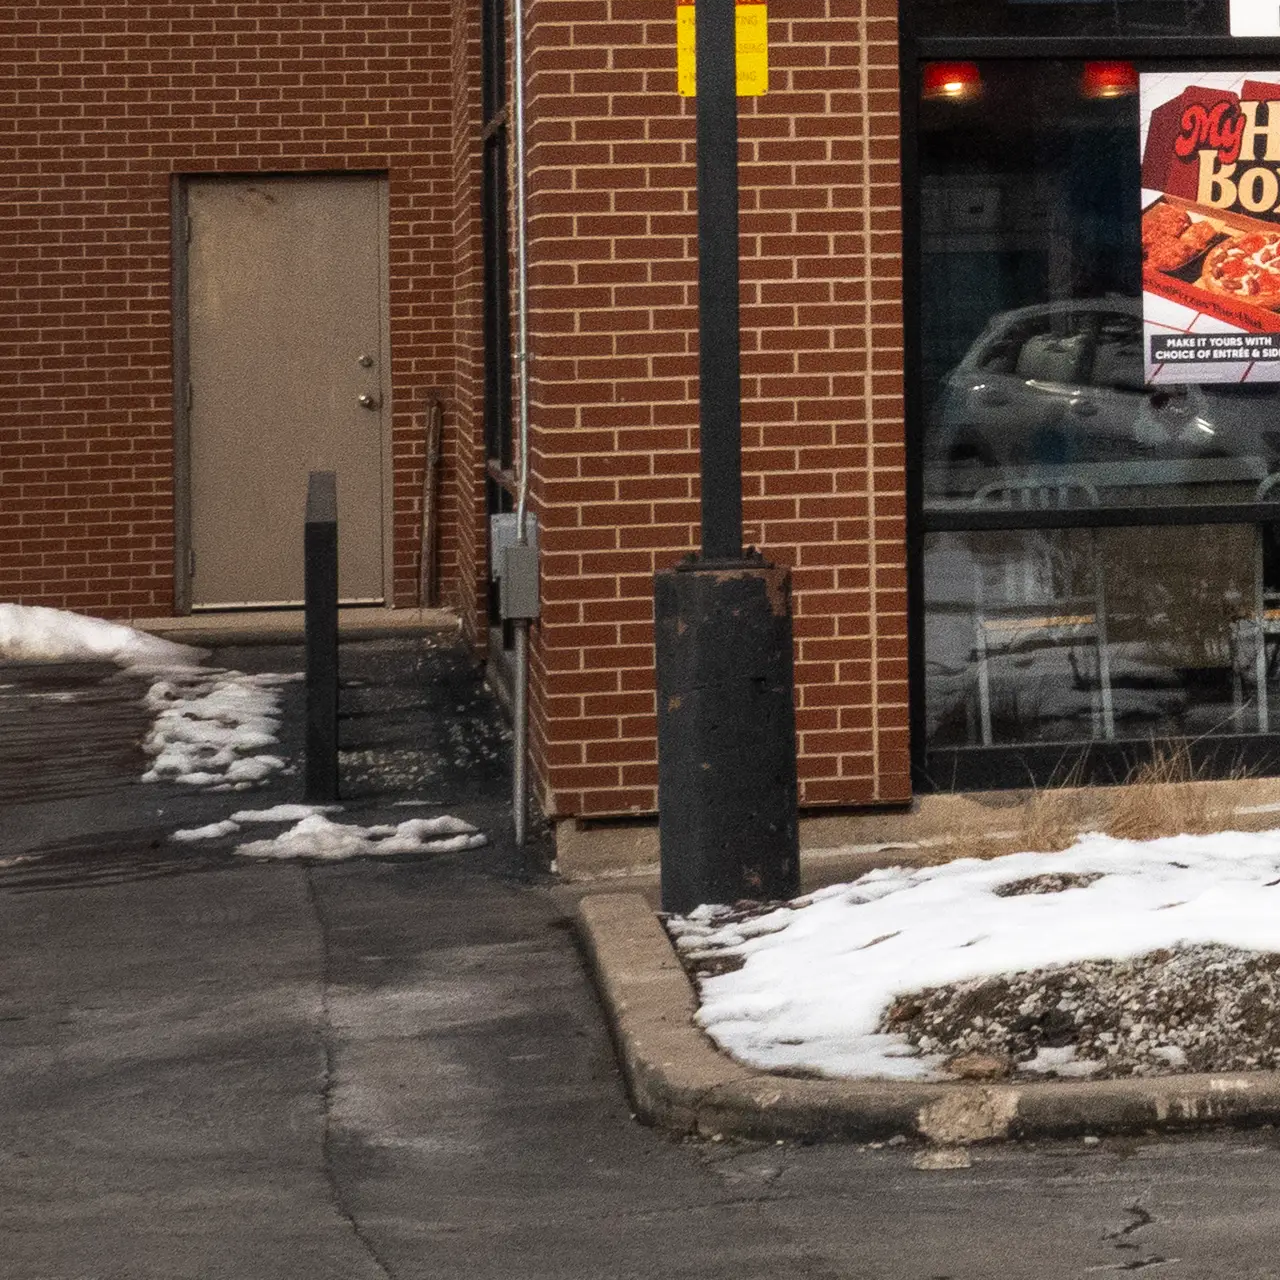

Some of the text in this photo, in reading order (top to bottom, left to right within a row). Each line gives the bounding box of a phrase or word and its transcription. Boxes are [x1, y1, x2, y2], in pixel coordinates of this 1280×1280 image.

[1175, 102, 1246, 164] My
[1167, 337, 1272, 347] MAKE IT YOURS WITH
[1155, 350, 1195, 360] CHOICE
[1197, 350, 1211, 359] OF
[1213, 347, 1250, 359] ENTRÉE
[1252, 349, 1260, 358] &
